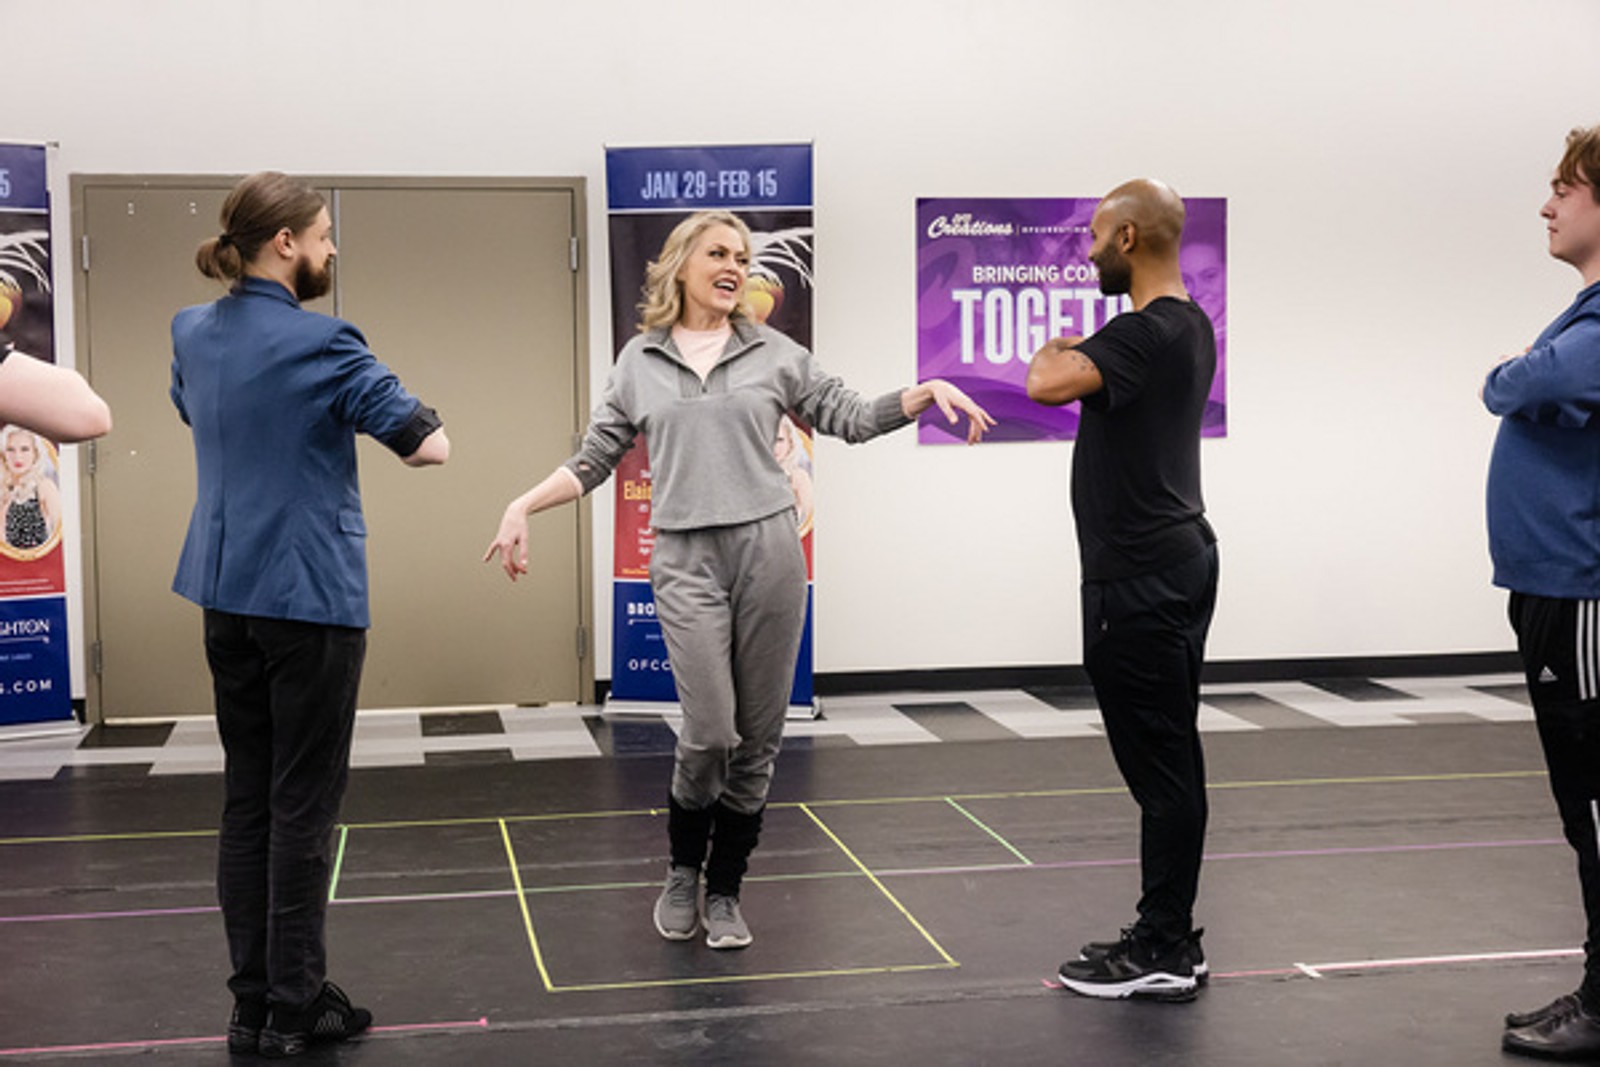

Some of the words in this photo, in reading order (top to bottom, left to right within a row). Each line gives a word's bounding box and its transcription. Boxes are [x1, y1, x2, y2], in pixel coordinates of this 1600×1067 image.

[641, 171, 679, 199] JAN
[757, 168, 778, 197] 15
[927, 215, 1014, 239] Creations
[972, 265, 1060, 284] BRINGING
[951, 287, 1133, 364] TOGET
